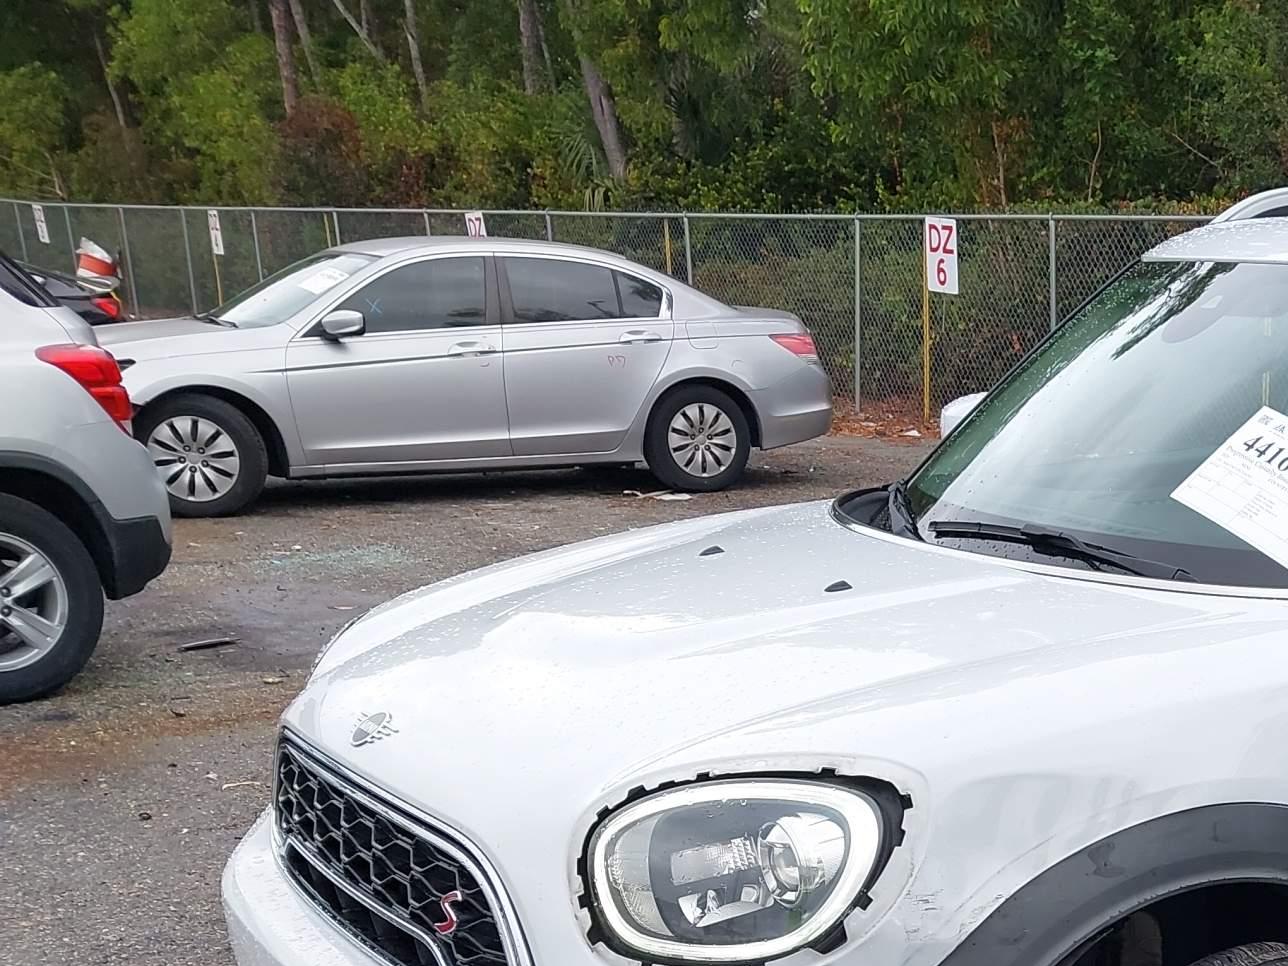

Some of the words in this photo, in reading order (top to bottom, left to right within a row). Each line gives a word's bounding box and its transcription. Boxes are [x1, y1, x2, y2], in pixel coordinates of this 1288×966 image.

[928, 223, 955, 255] DZ
[936, 258, 948, 287] 6
[433, 890, 463, 936] S
